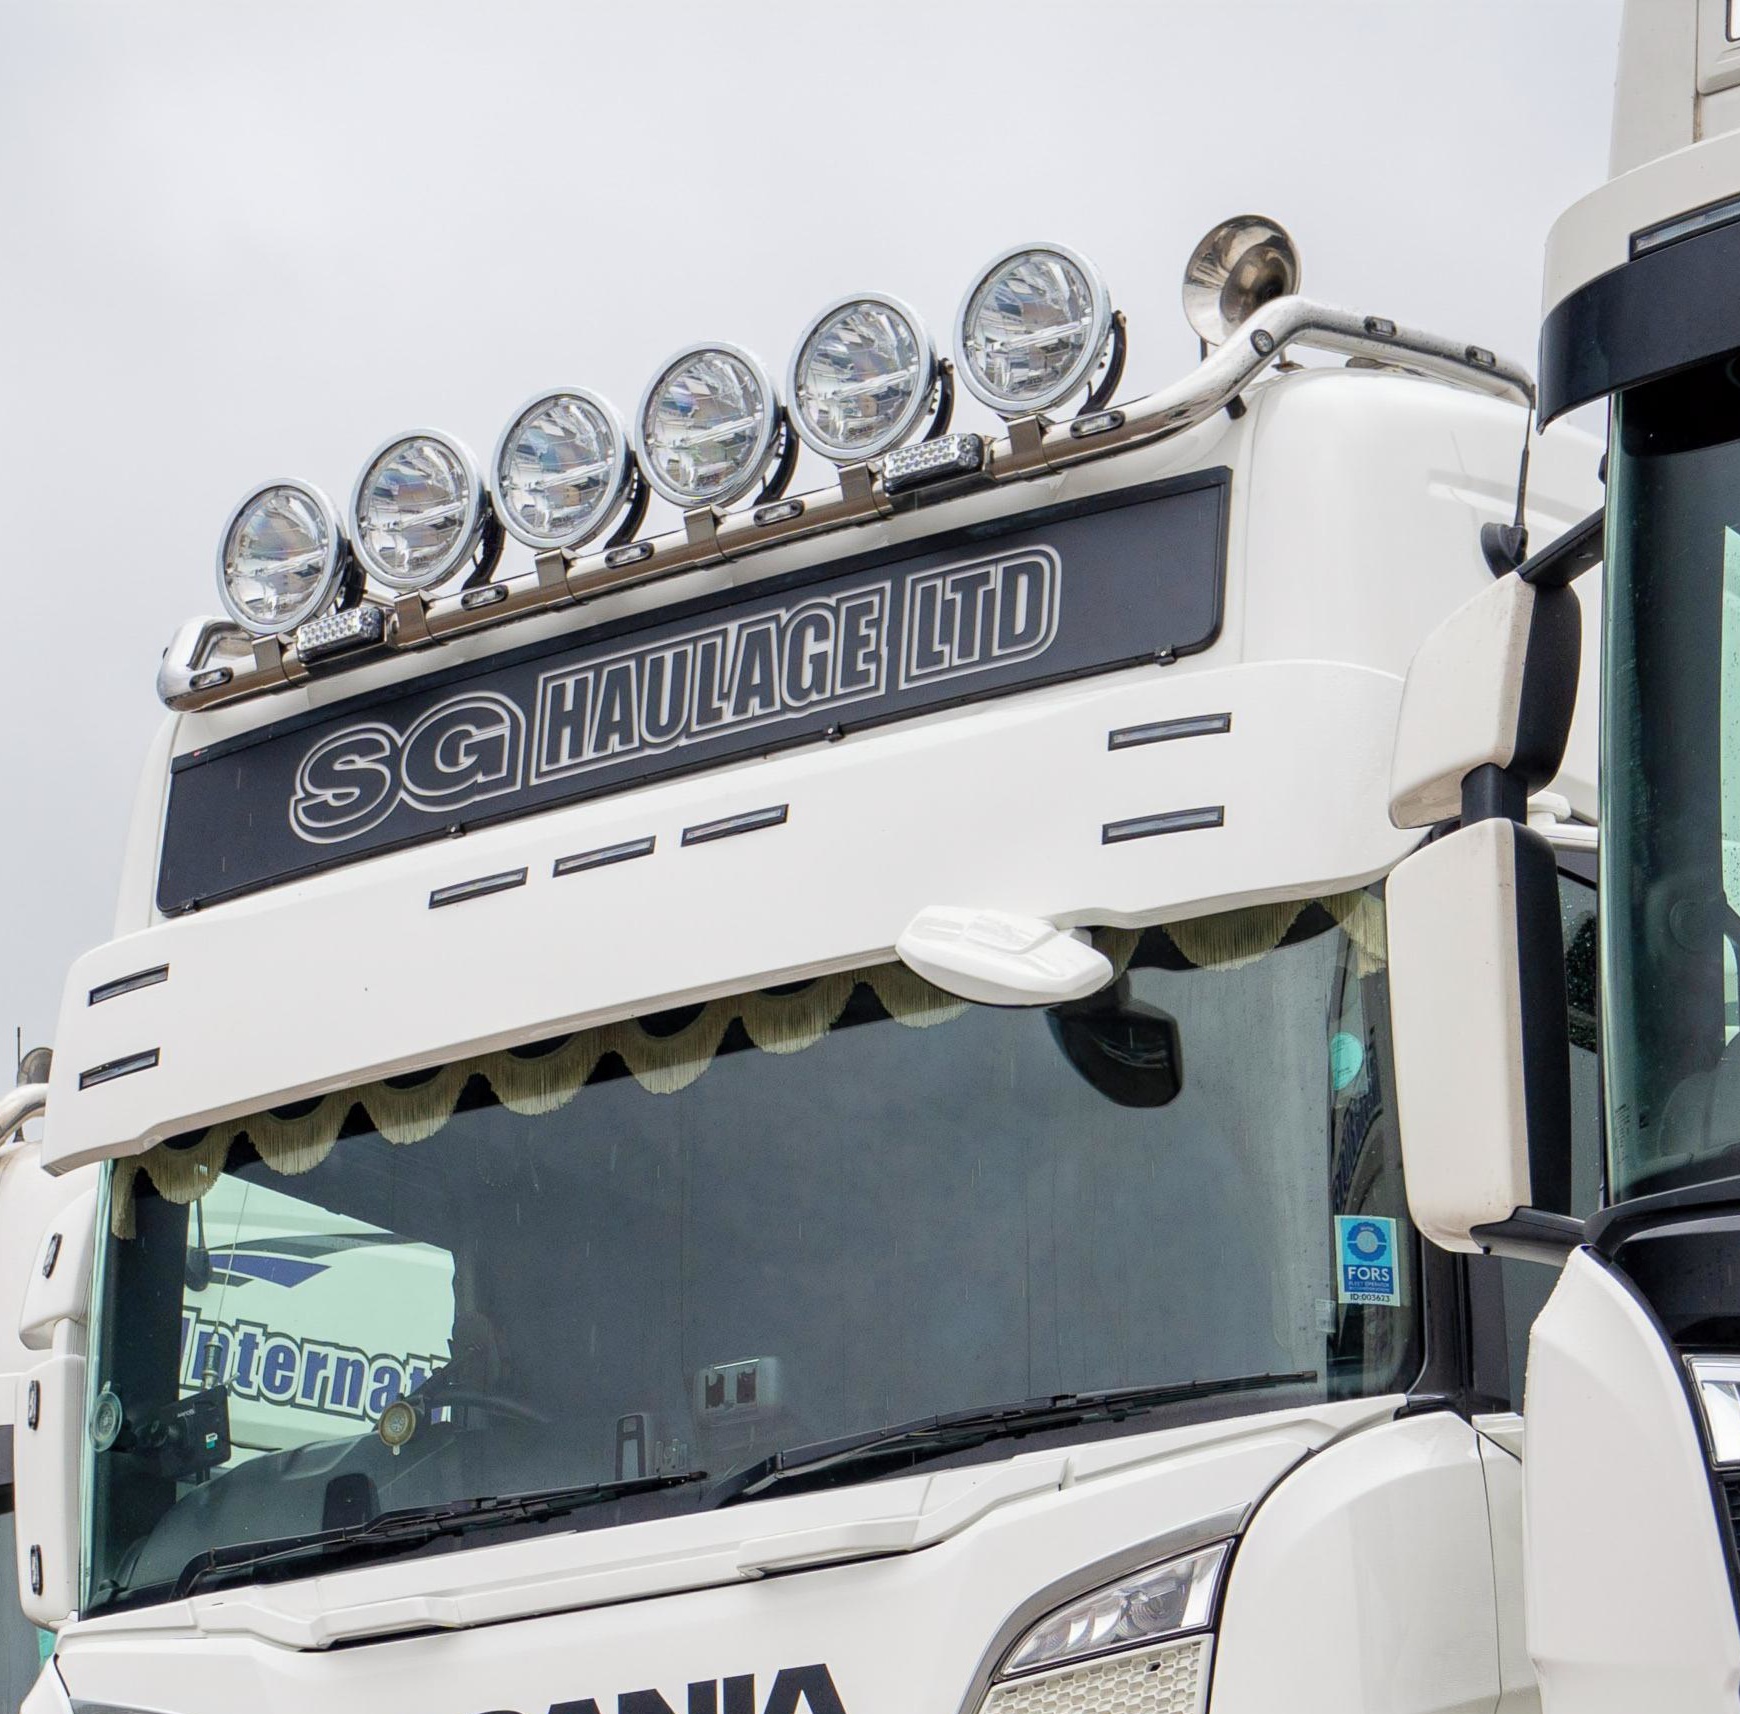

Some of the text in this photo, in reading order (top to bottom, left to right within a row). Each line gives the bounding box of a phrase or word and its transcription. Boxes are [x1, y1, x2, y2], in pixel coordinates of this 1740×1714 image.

[289, 544, 1061, 845] SG HAULAGE LTD
[1348, 1267, 1389, 1281] FORS
